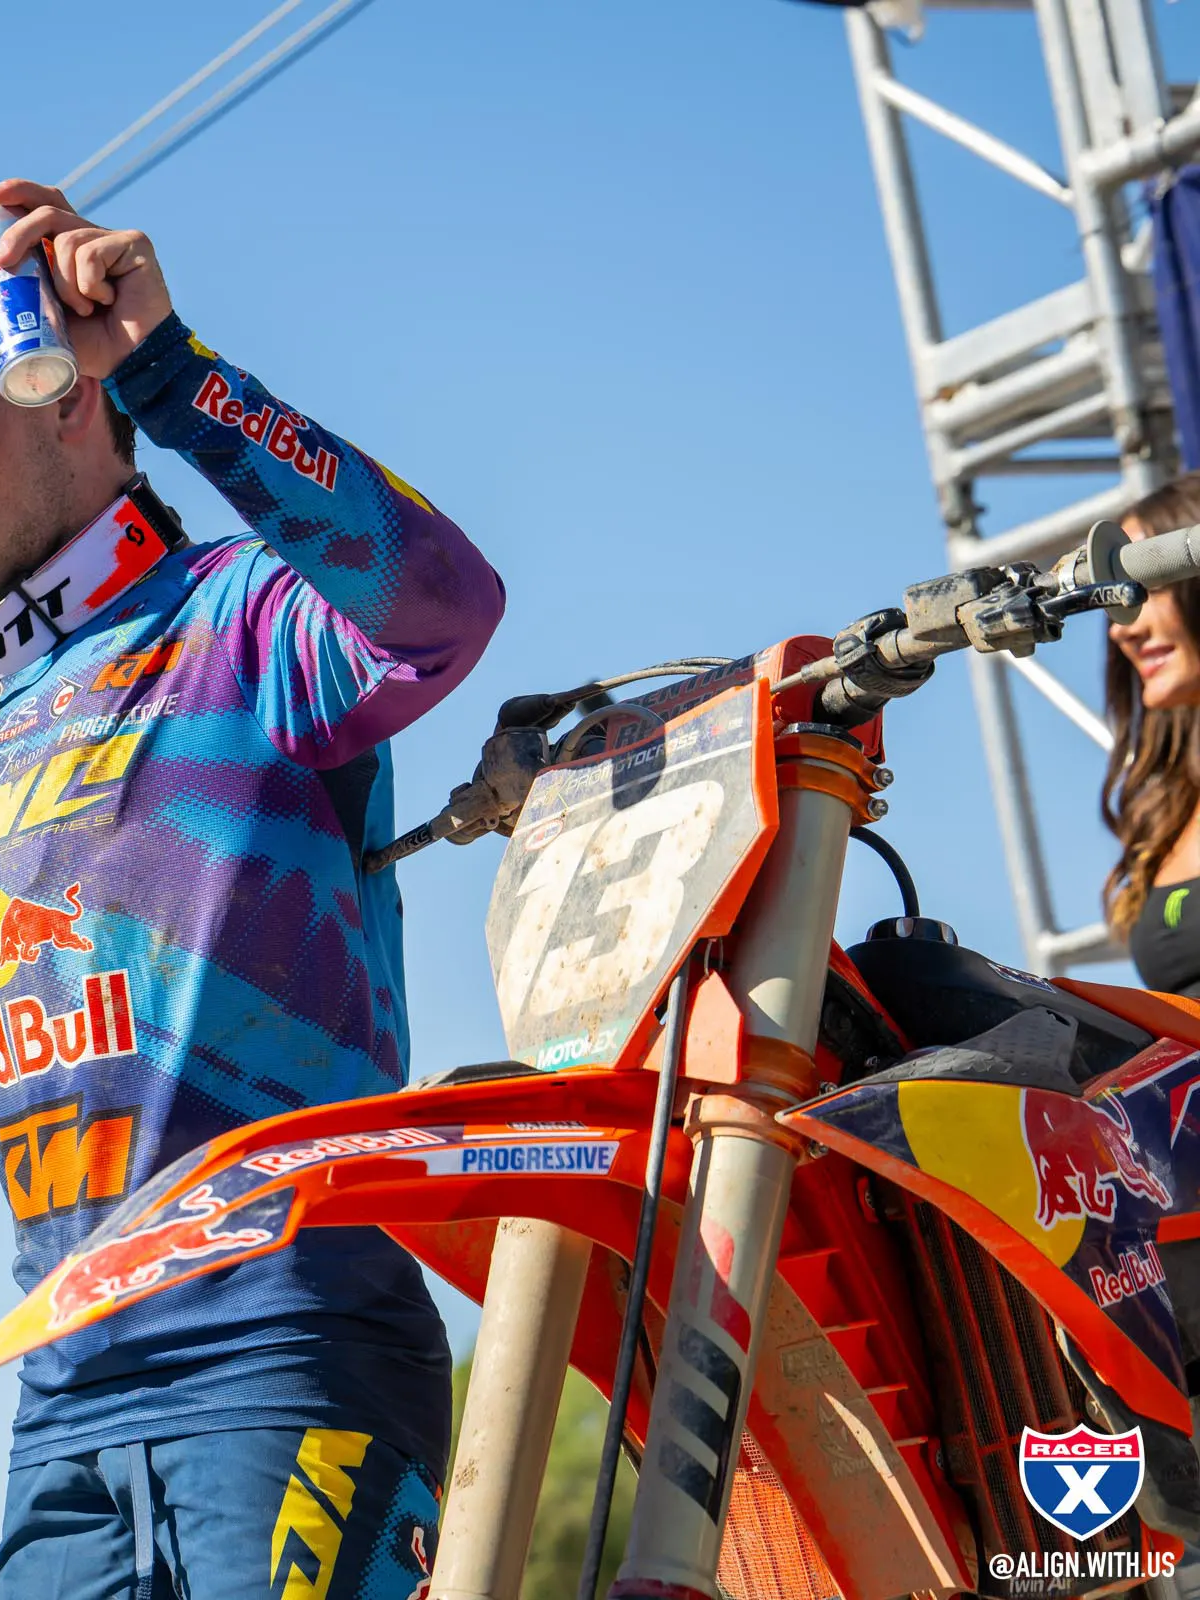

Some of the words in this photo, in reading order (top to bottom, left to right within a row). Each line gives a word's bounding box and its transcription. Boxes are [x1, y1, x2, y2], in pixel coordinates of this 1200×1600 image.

[192, 371, 275, 447] Red
[265, 413, 340, 493] Bull
[89, 641, 185, 692] KTM
[58, 692, 180, 746] PROGRSSIVE
[497, 779, 725, 1034] 13
[5, 968, 138, 1080] Bull
[241, 1138, 360, 1177] Red
[336, 1126, 447, 1153] Bull
[461, 1145, 610, 1173] PROGRESSIVE
[1088, 1253, 1136, 1308] Red
[1125, 1240, 1166, 1292] Bull
[1009, 1577, 1045, 1593] Twin
